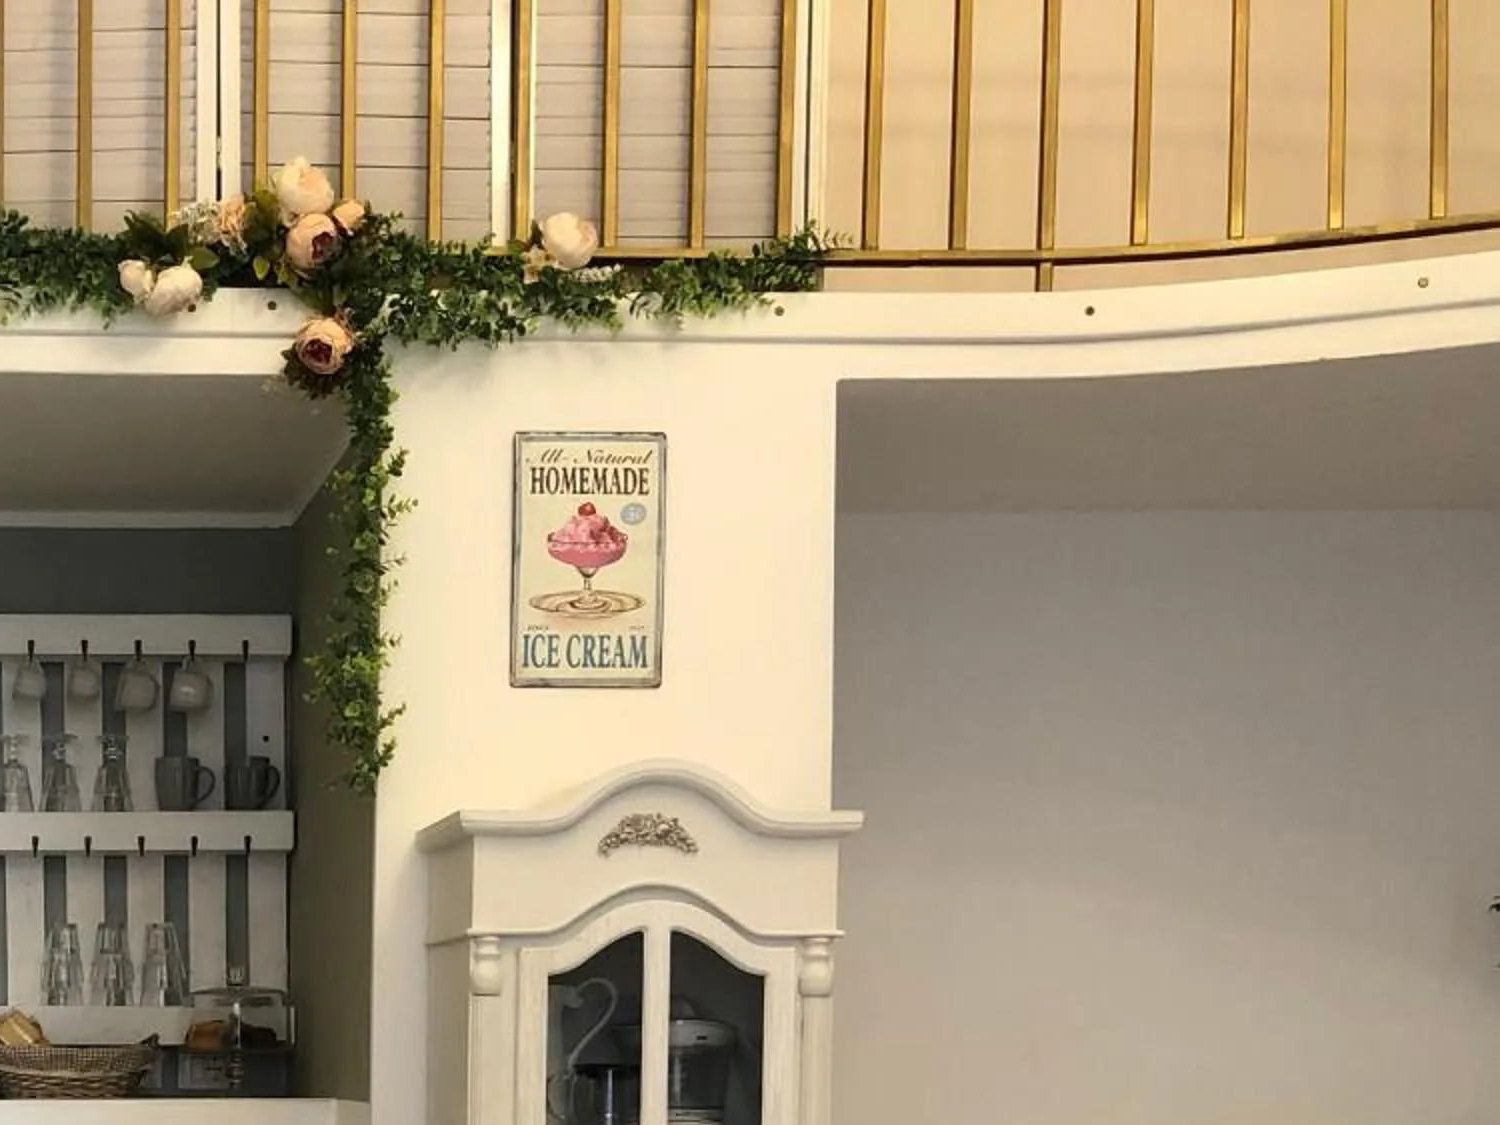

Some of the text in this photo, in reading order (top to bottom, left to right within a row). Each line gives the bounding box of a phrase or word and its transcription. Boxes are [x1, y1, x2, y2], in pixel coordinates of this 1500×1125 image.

[530, 466, 650, 495] HOMEMADE
[522, 634, 648, 668] ICE CREAM
